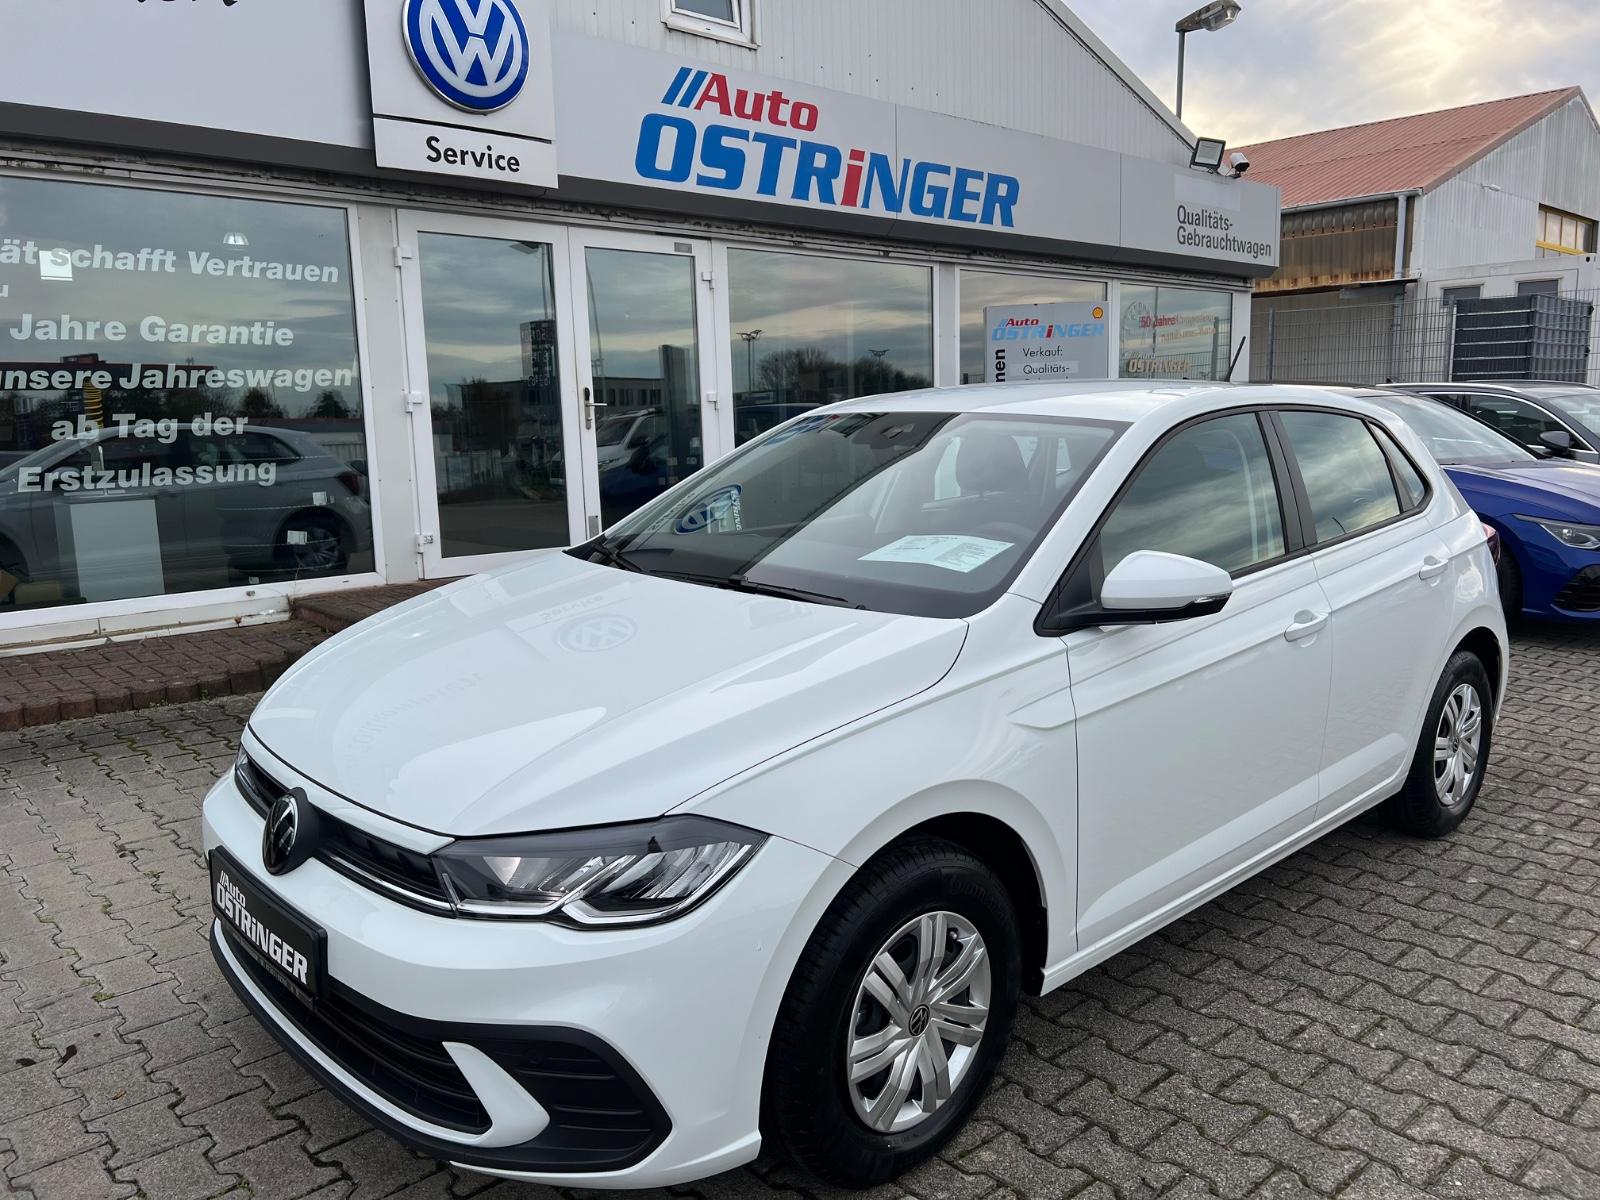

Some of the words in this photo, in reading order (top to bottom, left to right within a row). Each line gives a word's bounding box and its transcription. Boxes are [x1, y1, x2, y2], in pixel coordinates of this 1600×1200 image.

[426, 136, 520, 172] Service
[1177, 204, 1233, 231] Qualitäts-
[1177, 226, 1271, 259] Gebrauchtwagen
[50, 244, 176, 272] schafft
[188, 251, 338, 282] Vertrauen
[10, 314, 127, 341] Jahre
[140, 315, 294, 346] Garantie
[1023, 345, 1063, 357] Verkauf:
[0, 369, 112, 390] nsere
[119, 363, 351, 392] Jahreswagen
[1023, 364, 1070, 375] Qualitäts-
[51, 415, 99, 440] ab
[112, 413, 178, 444] Tag
[191, 412, 248, 436] der
[18, 462, 276, 492] Erstzulassung
